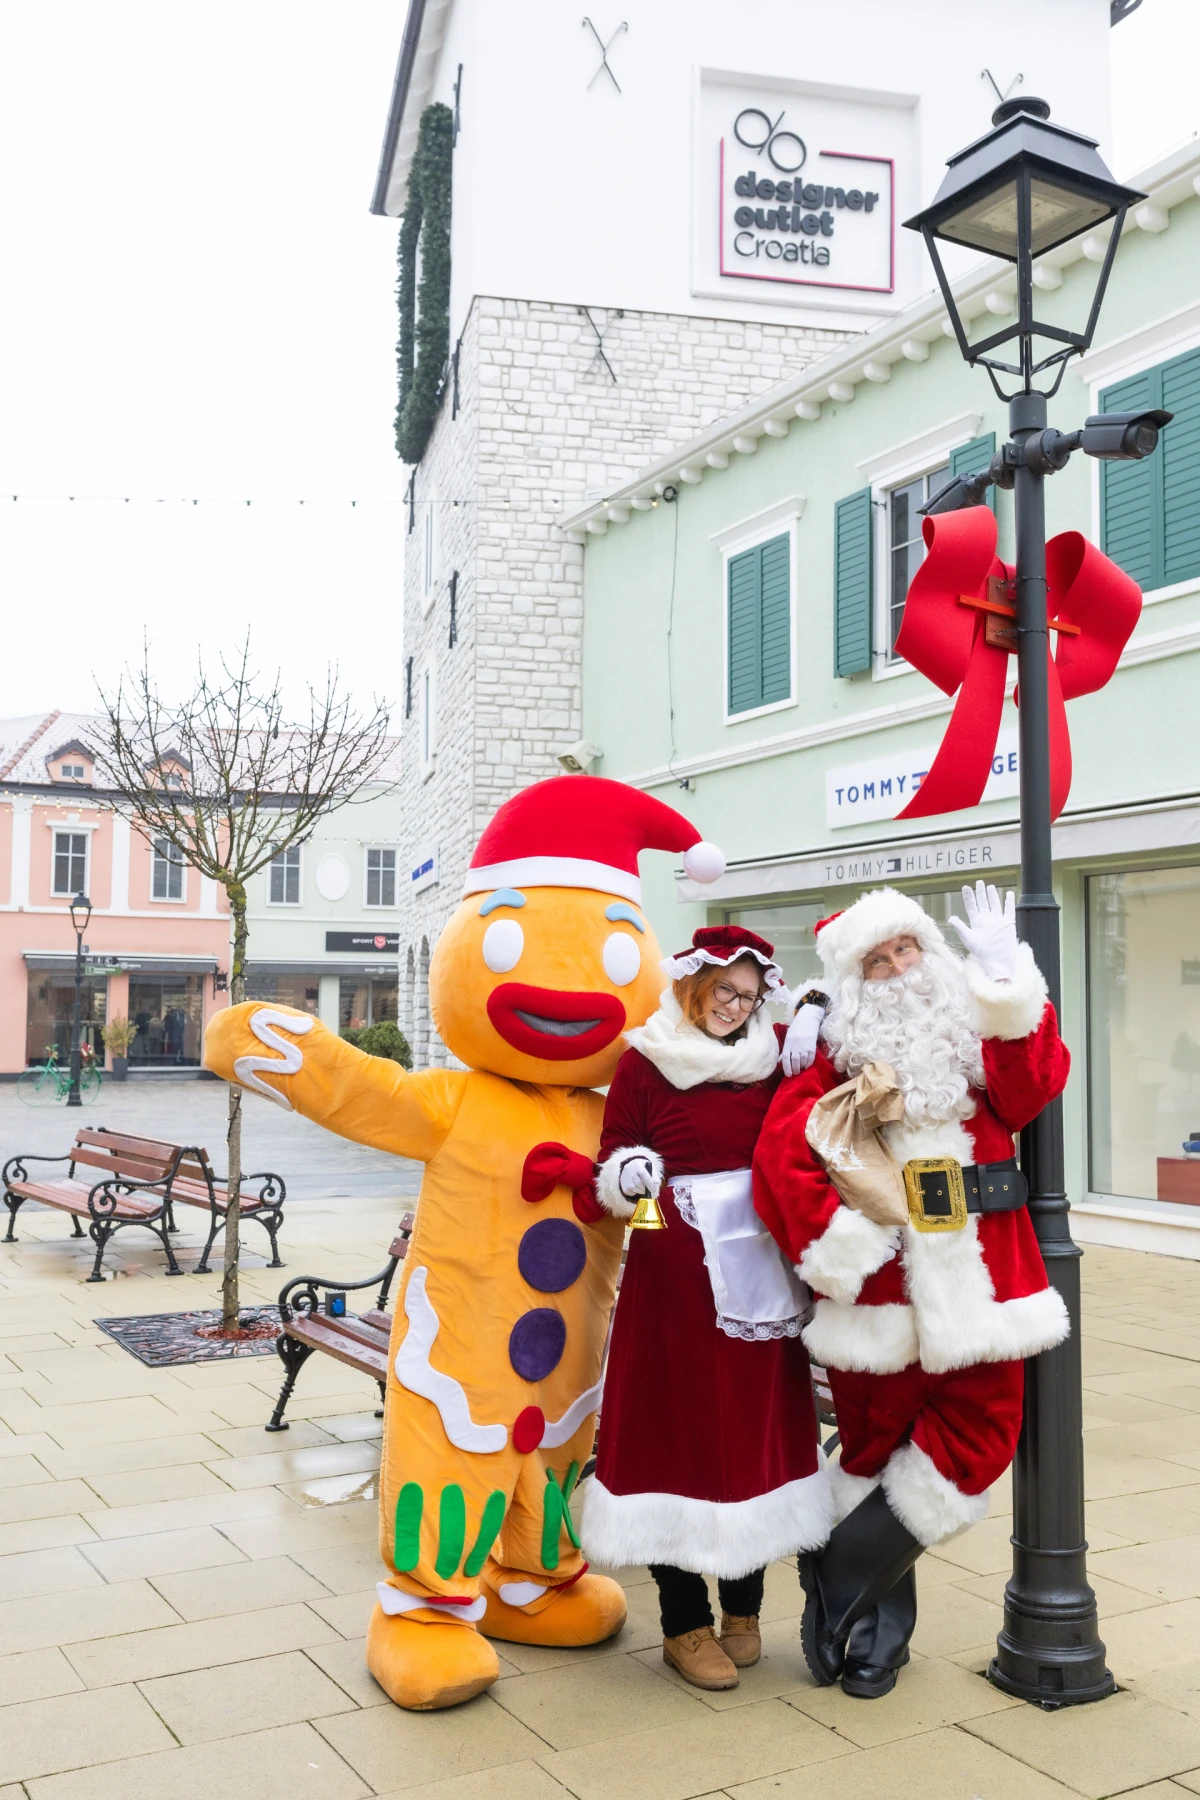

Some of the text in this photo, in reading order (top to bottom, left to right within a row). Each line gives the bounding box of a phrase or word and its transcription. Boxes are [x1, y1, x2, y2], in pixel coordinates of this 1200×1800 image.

[735, 171, 878, 212] designer
[735, 205, 834, 236] outlet
[735, 231, 830, 265] Croatia
[835, 775, 907, 806] TOMMY
[825, 846, 993, 881] TOMMY HILFIGER
